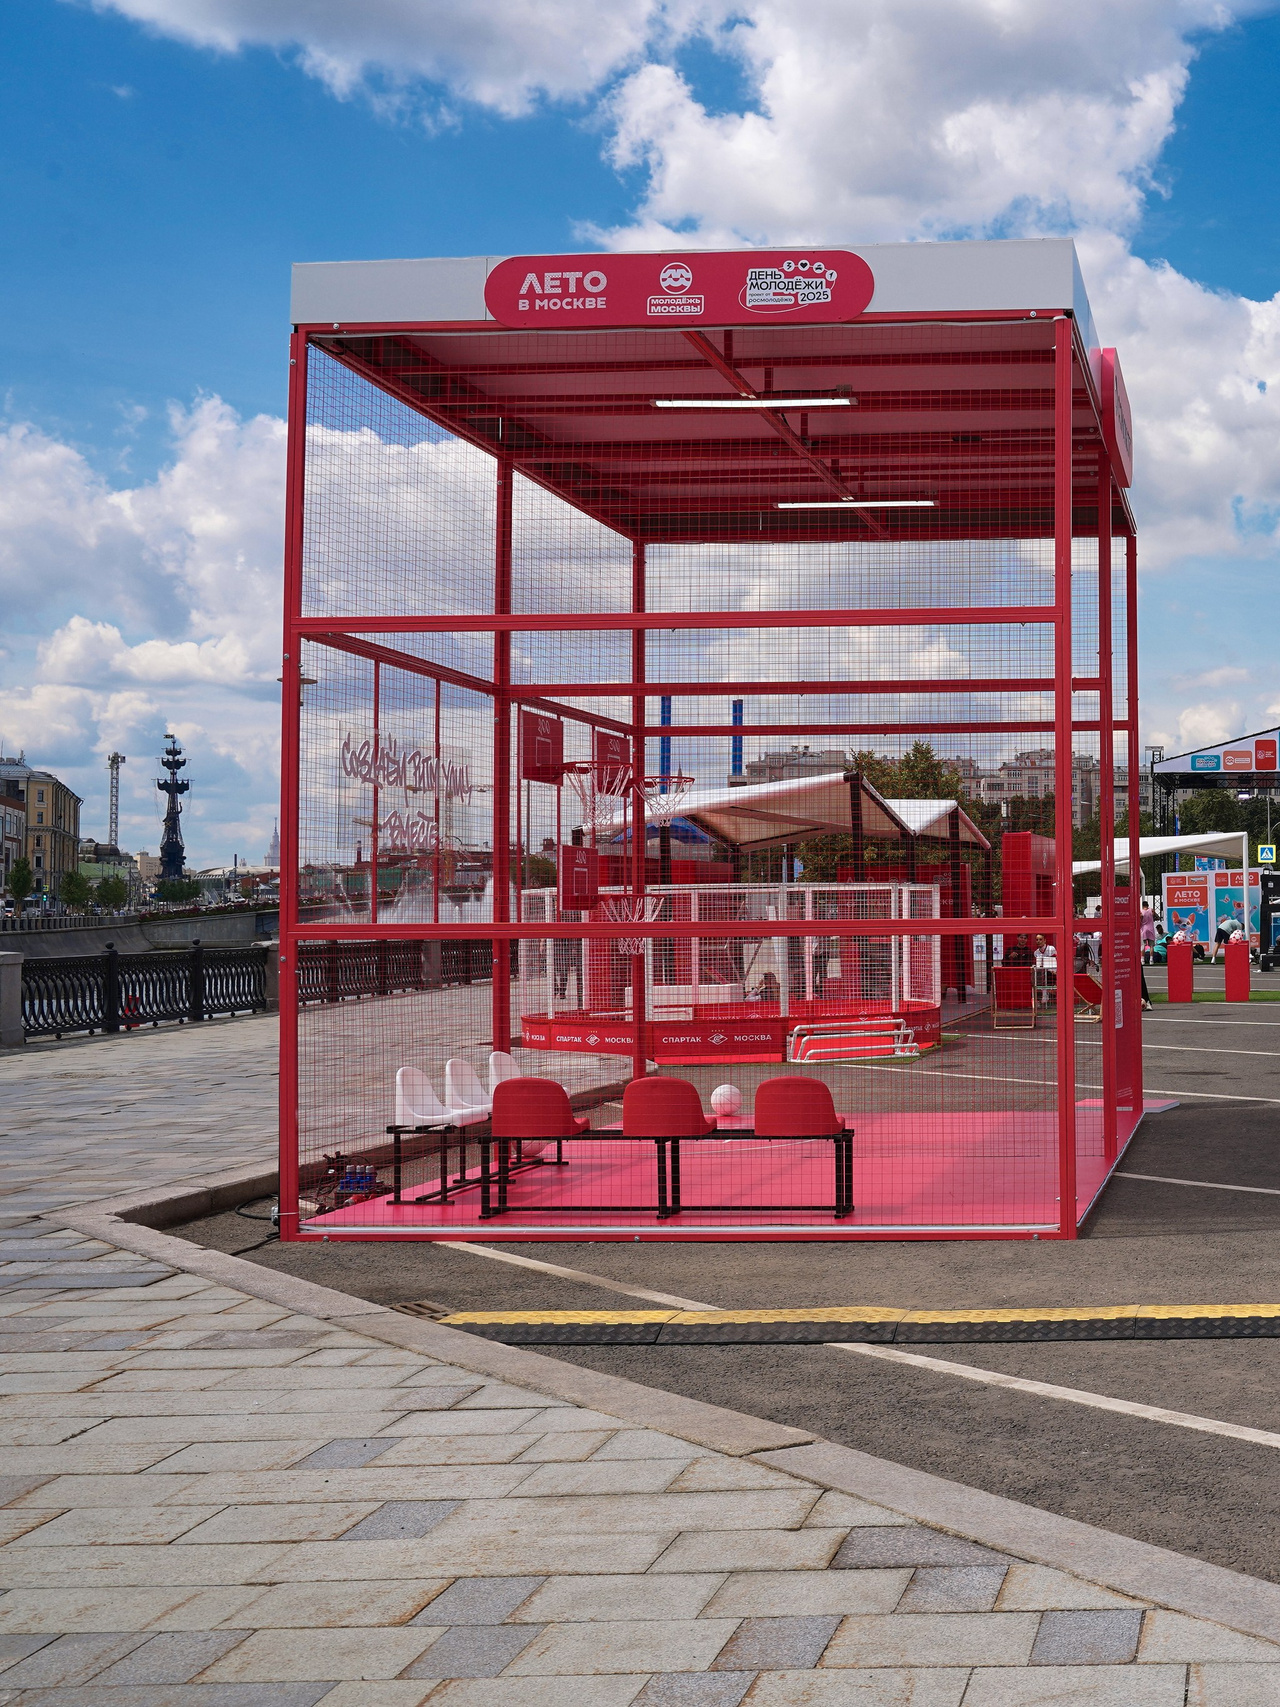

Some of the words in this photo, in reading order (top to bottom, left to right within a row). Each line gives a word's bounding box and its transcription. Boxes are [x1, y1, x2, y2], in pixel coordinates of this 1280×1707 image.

[749, 270, 782, 281] ДЕНЬ
[519, 271, 607, 294] ЛЕТО
[749, 279, 824, 291] МОЛОДЁЖИ
[800, 291, 829, 302] 2025
[518, 299, 530, 310] В
[535, 297, 606, 310] МОСКВЕ
[1174, 890, 1201, 898] ЛЕТО
[556, 1035, 582, 1043] СПАРТАК
